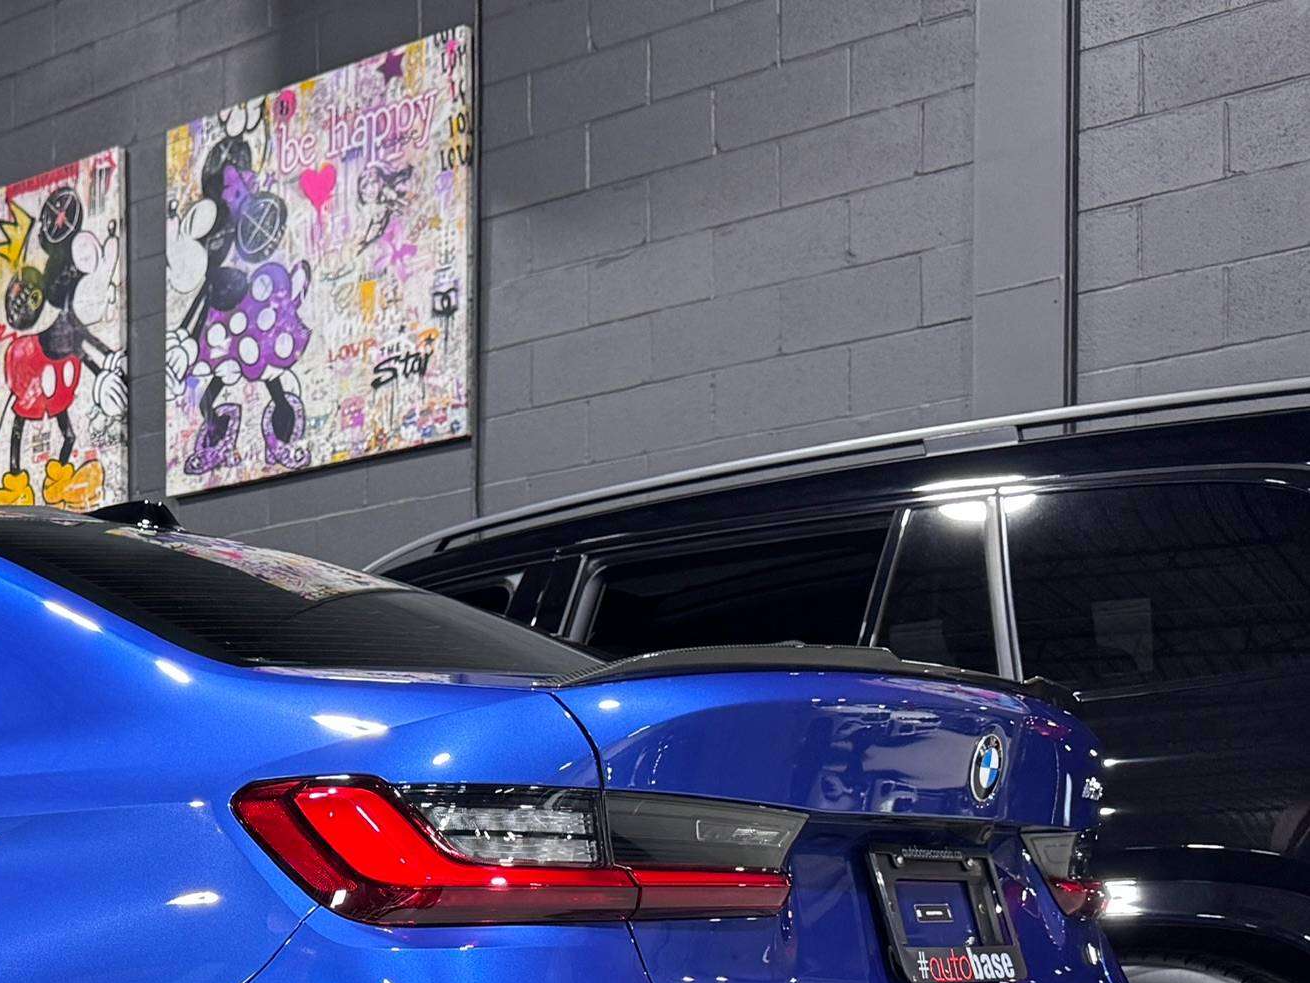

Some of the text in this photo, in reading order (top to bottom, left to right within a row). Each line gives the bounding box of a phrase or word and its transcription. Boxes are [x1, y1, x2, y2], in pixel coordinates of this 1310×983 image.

[277, 88, 438, 174] be happy
[380, 342, 401, 356] THE
[917, 947, 1015, 982] #autobase
